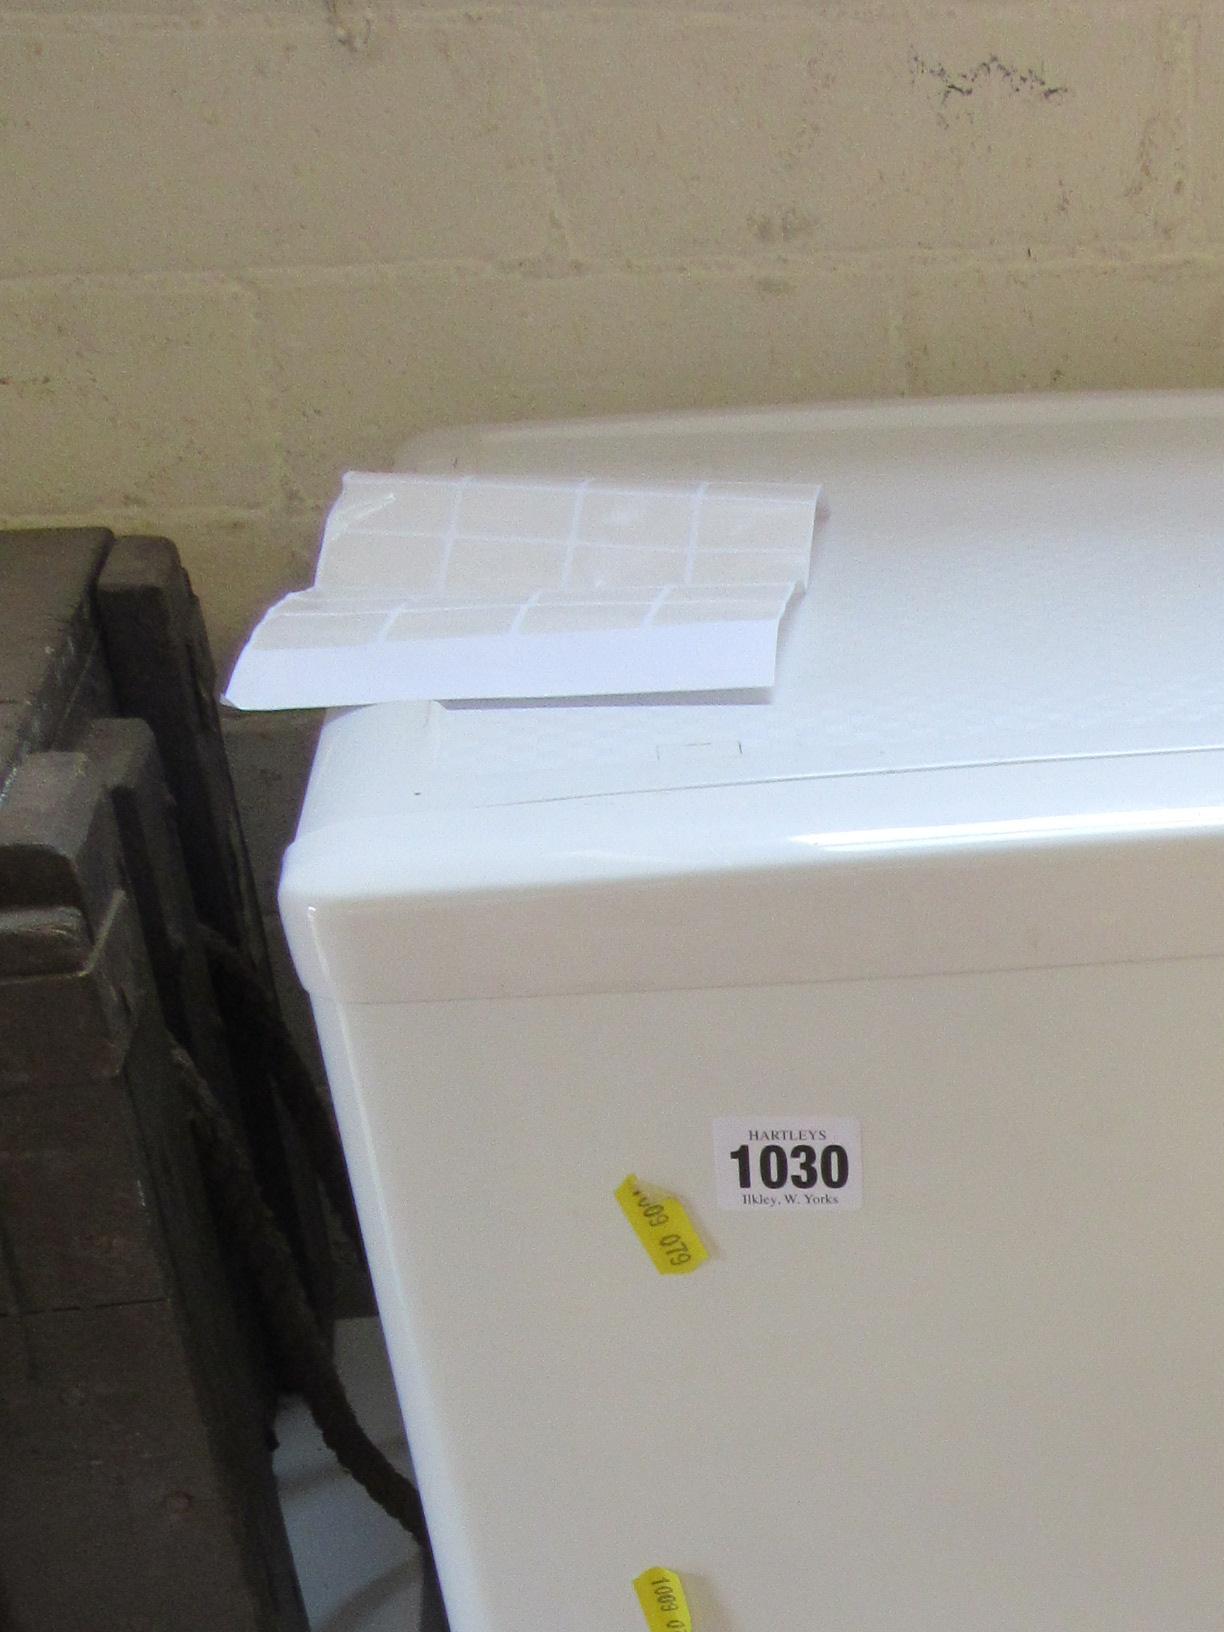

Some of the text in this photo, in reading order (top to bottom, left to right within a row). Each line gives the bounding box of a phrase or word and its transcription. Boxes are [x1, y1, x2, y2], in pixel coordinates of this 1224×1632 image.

[749, 1129, 827, 1141] HARTLEYS
[730, 1144, 849, 1189] 1030
[784, 1194, 800, 1205] W.
[805, 1194, 839, 1205] Yorks
[659, 1234, 691, 1266] 079
